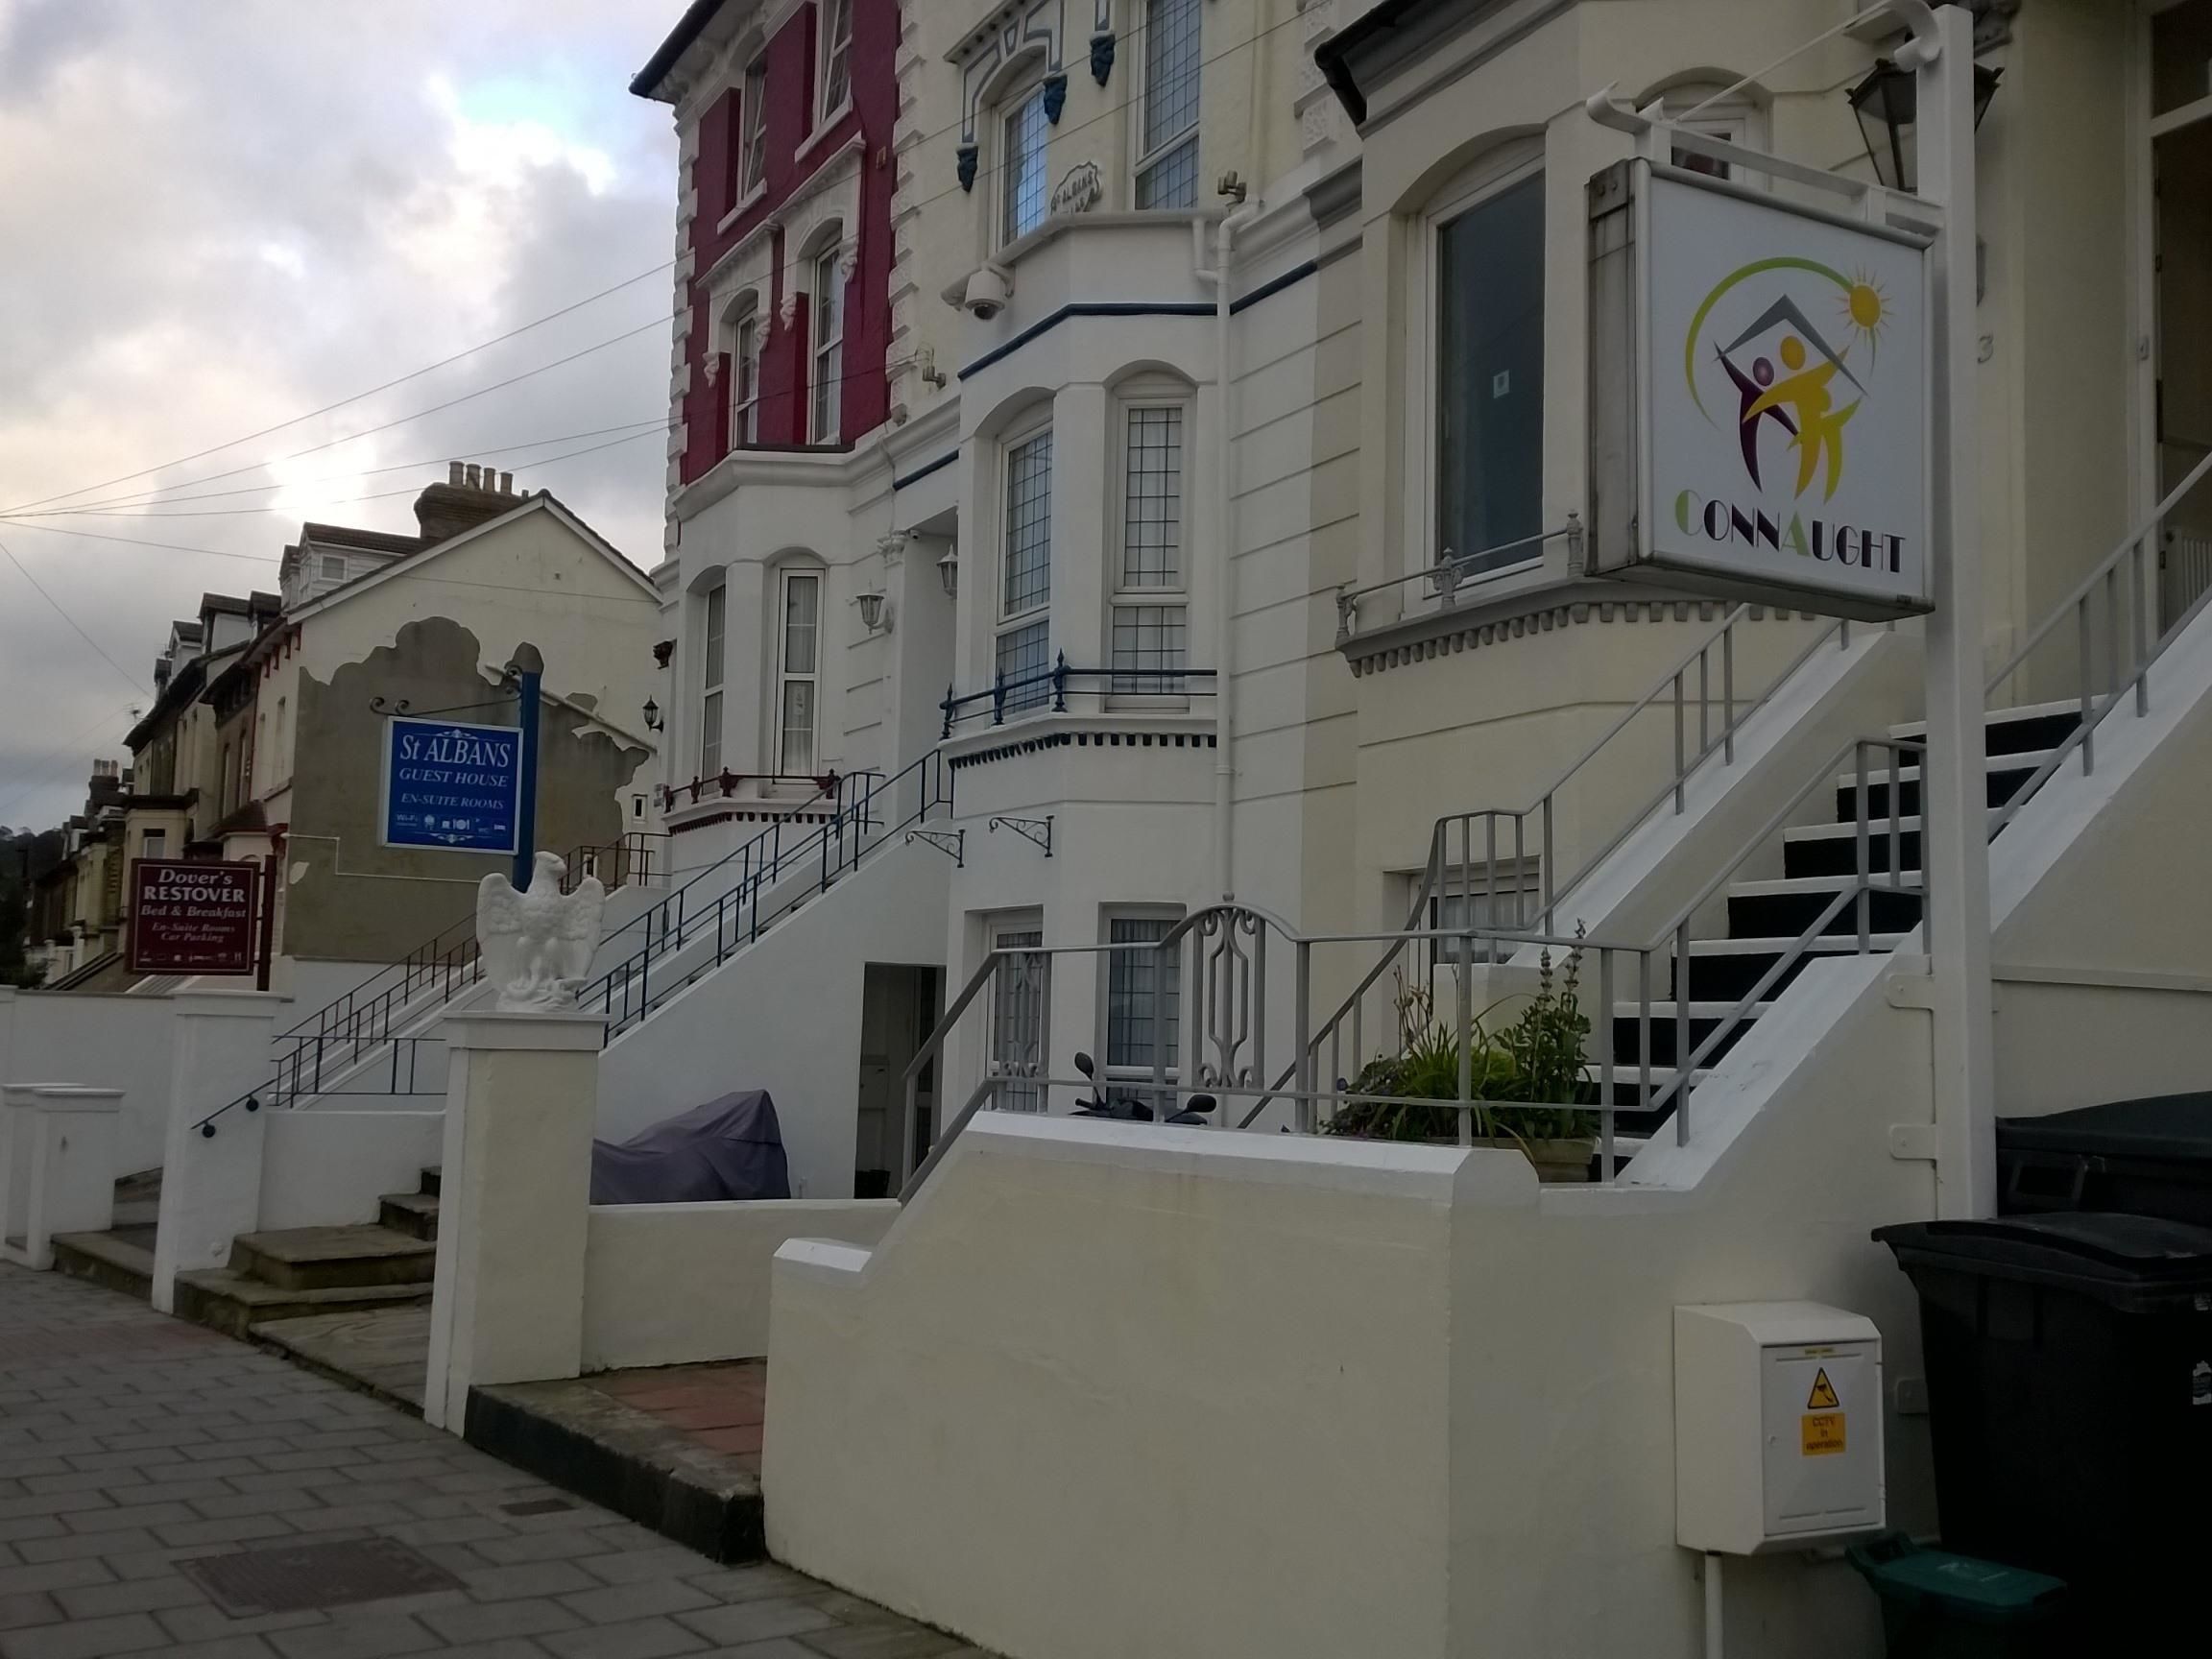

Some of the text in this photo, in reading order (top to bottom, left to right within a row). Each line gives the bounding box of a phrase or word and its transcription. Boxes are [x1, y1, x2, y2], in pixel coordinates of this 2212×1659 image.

[1977, 334, 1994, 364] 3
[1674, 489, 1907, 573] CONNAUGHT
[399, 734, 511, 768] St ALBANS
[398, 767, 509, 787] GUEST HOUSE
[401, 793, 505, 809] EN-SUITE ROOMS
[158, 868, 233, 885] Dover's
[144, 885, 246, 903] RESTOVER
[140, 904, 247, 920] Bed & Breakfast
[152, 922, 235, 933] En-Suite Rooms
[160, 931, 225, 943] Car Parking
[1812, 1415, 1836, 1428] CCTV
